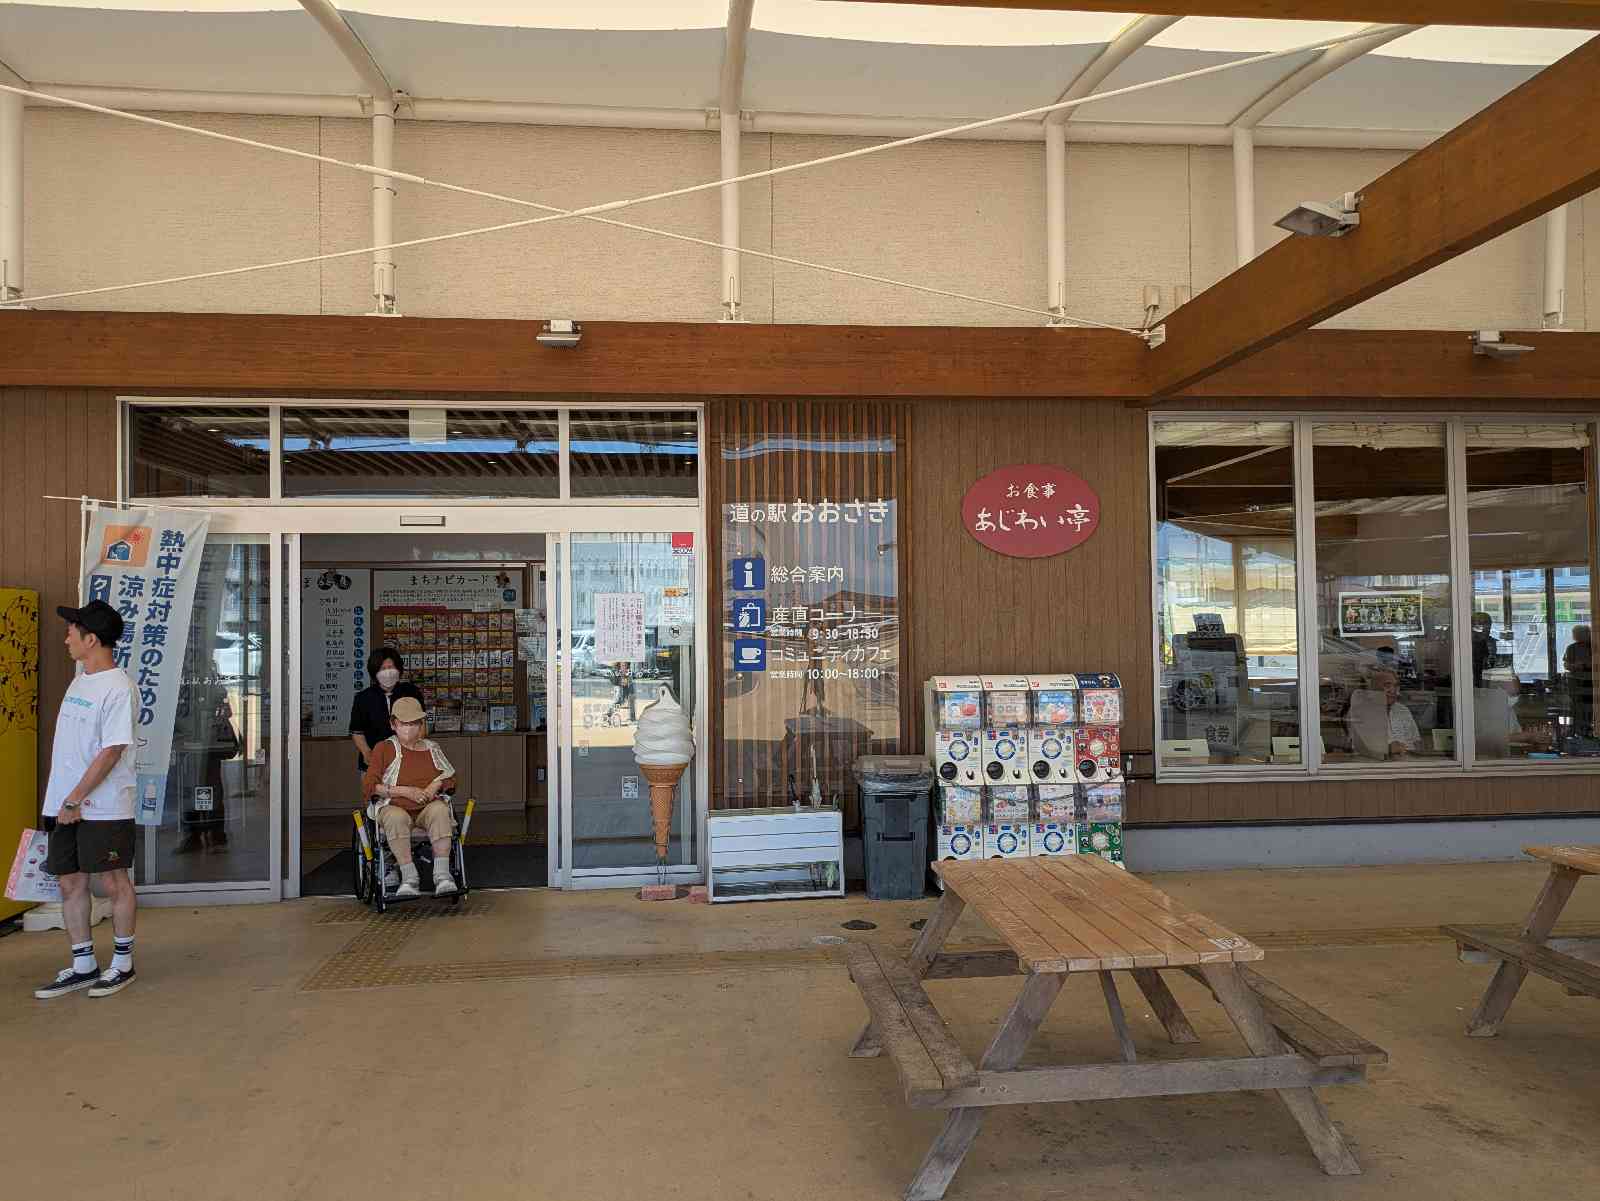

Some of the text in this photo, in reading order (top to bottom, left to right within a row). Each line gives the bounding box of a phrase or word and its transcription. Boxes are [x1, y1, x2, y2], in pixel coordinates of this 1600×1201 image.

[1006, 482, 1057, 499] お食事
[729, 498, 889, 524] 道の駅おおさき
[975, 503, 1091, 532] あじわい亭
[770, 565, 844, 584] 総合案内
[771, 606, 881, 624] 産直コーナー
[137, 528, 187, 726] 熱中症対策のための
[769, 646, 891, 663] コミュニティカフェ
